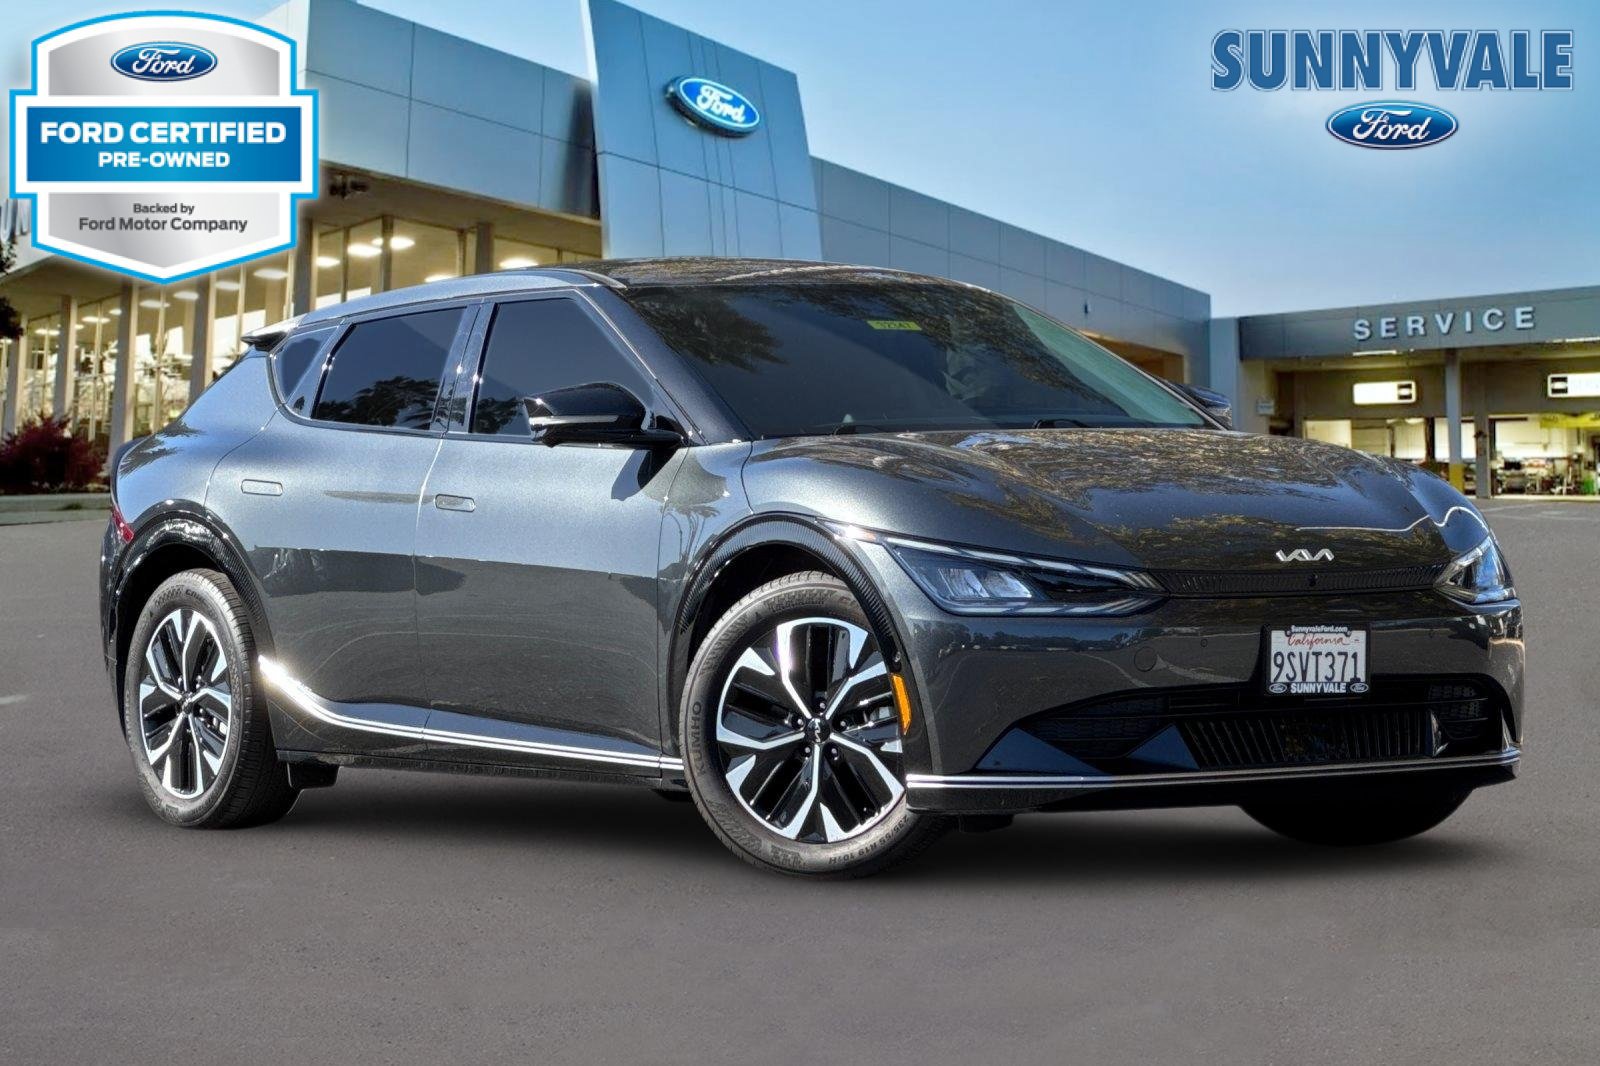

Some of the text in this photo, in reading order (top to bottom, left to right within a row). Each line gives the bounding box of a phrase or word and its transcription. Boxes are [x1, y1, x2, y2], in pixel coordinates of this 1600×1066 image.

[696, 84, 746, 123] Ford
[1353, 305, 1536, 341] SERVICE
[1290, 624, 1348, 634] SunnyvaleFord.com
[1287, 633, 1350, 651] California
[1273, 651, 1361, 683] 9SVT371
[1290, 682, 1348, 694] SUNNYVALE
